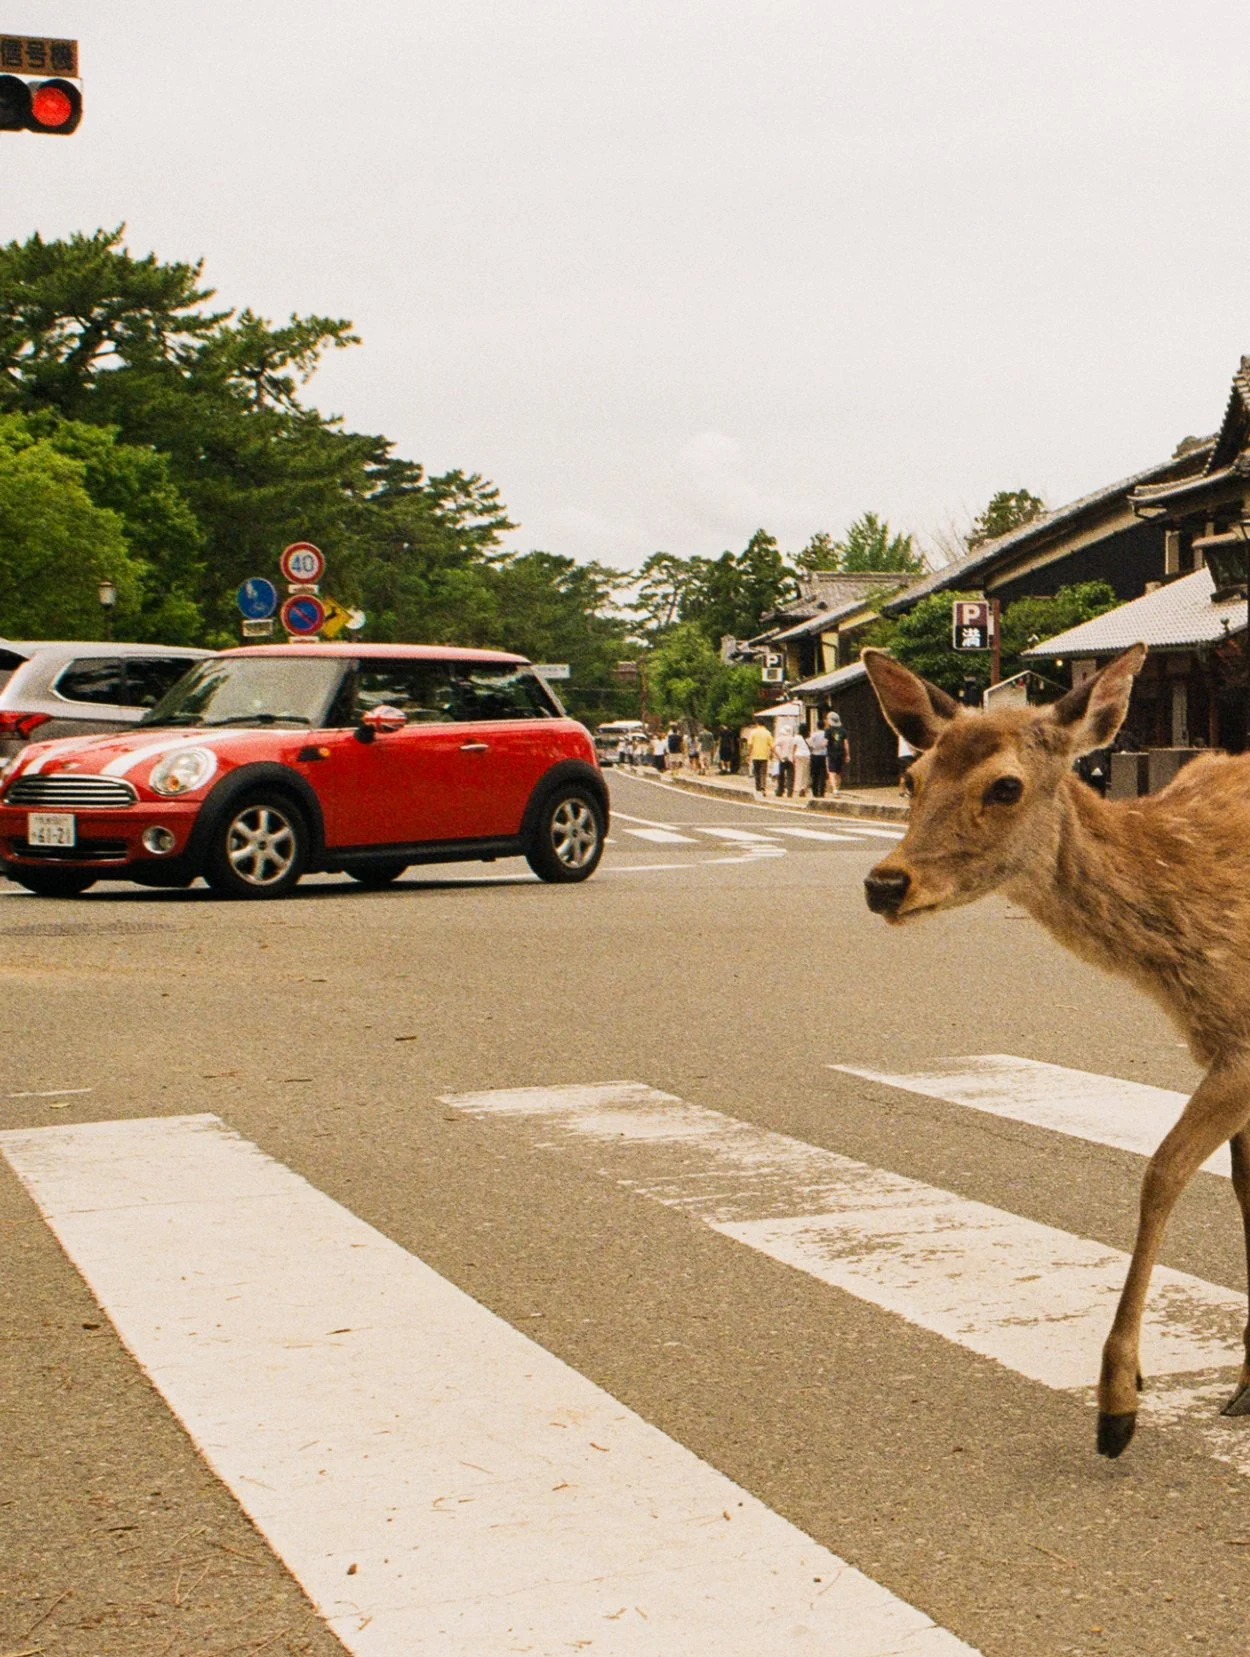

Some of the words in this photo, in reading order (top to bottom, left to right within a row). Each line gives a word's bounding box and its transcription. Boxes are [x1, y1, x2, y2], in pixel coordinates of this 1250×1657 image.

[292, 555, 314, 572] 40
[963, 604, 980, 625] P
[766, 655, 779, 667] P
